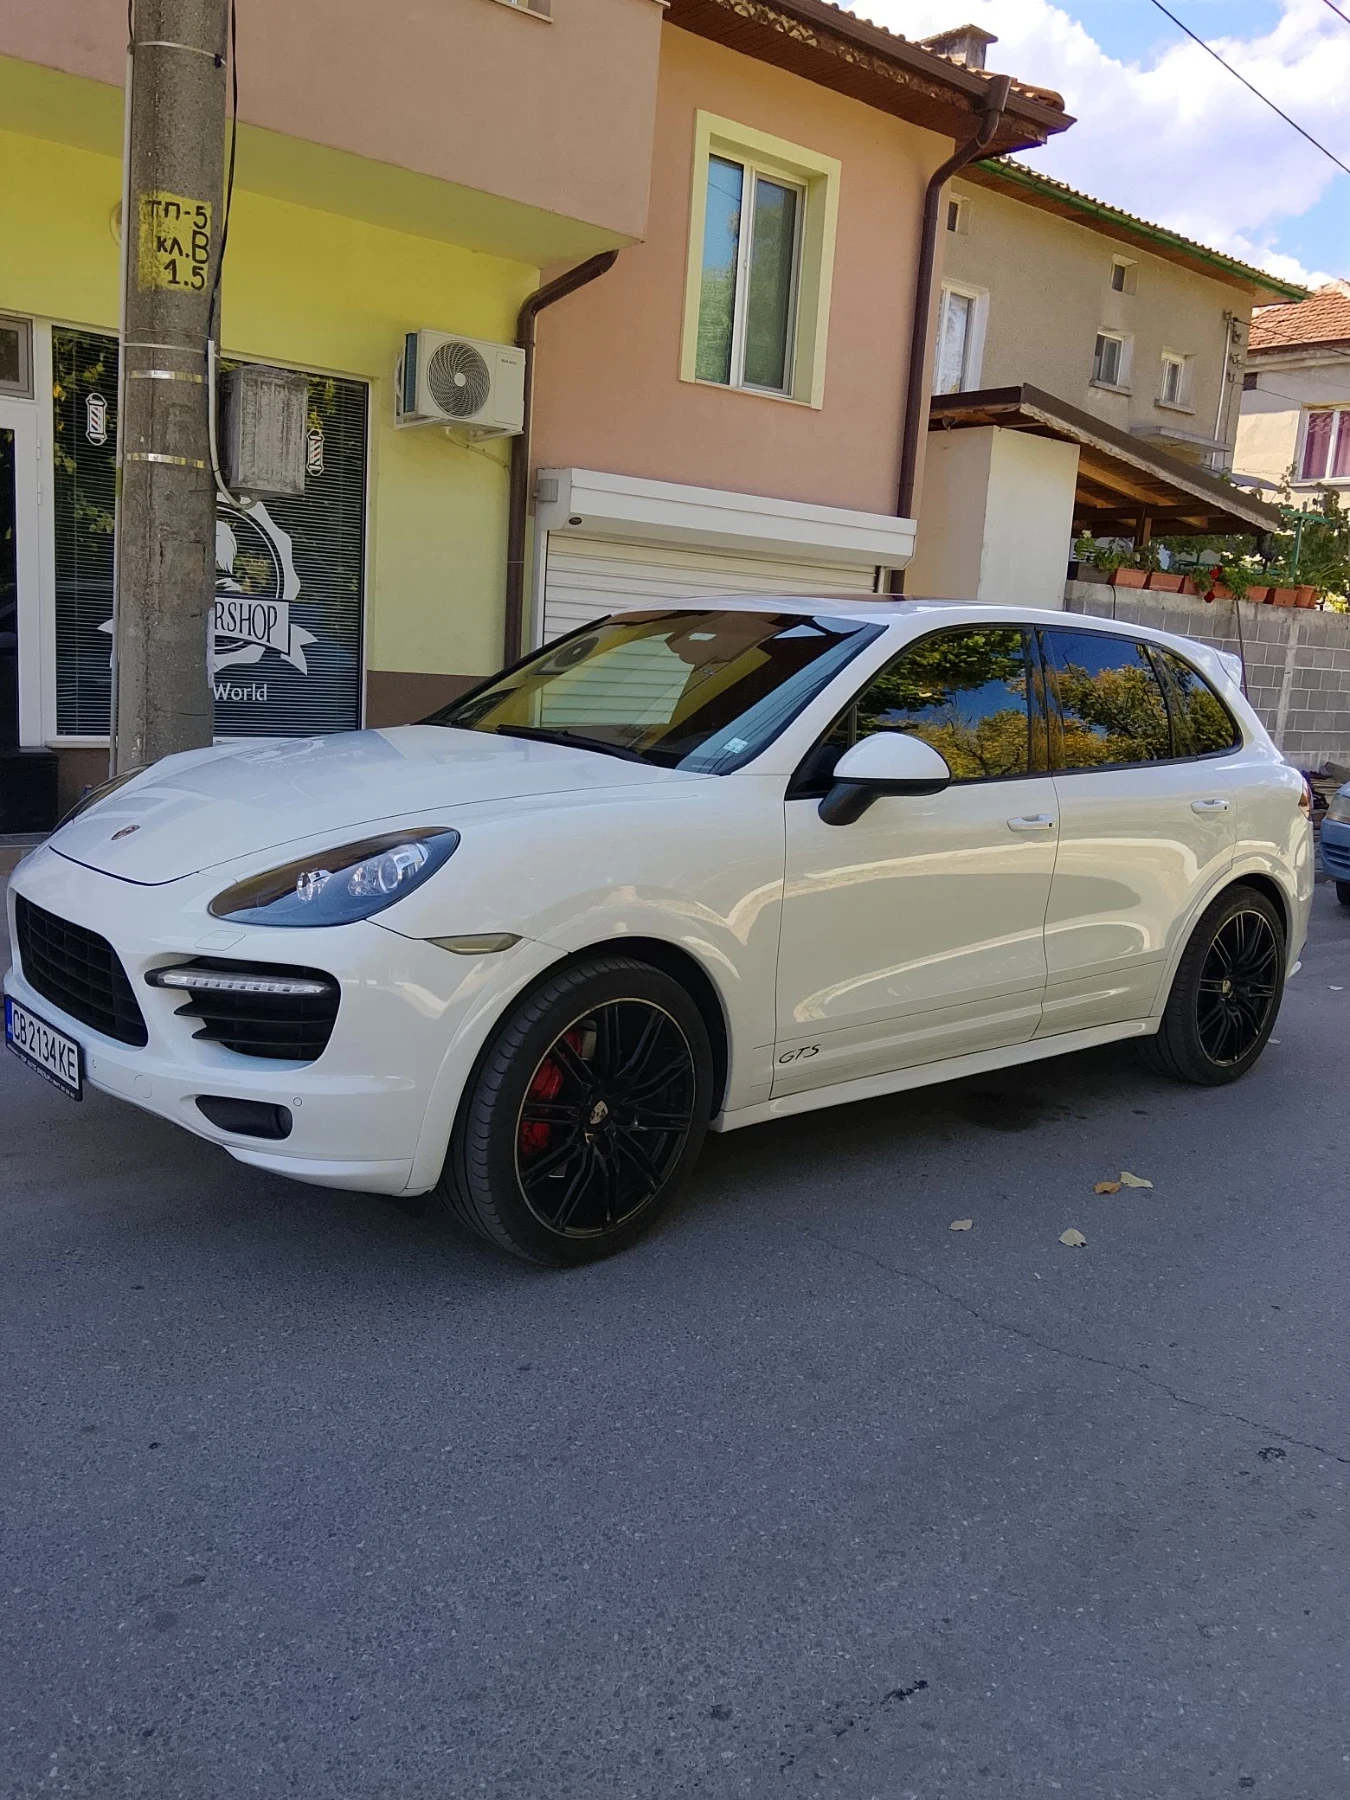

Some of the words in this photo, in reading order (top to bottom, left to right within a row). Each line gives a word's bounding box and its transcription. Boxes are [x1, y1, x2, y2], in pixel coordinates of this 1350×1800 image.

[163, 258, 205, 291] 1.5
[214, 601, 278, 644] RSHOP
[213, 682, 268, 701] World
[778, 1043, 821, 1064] GTS
